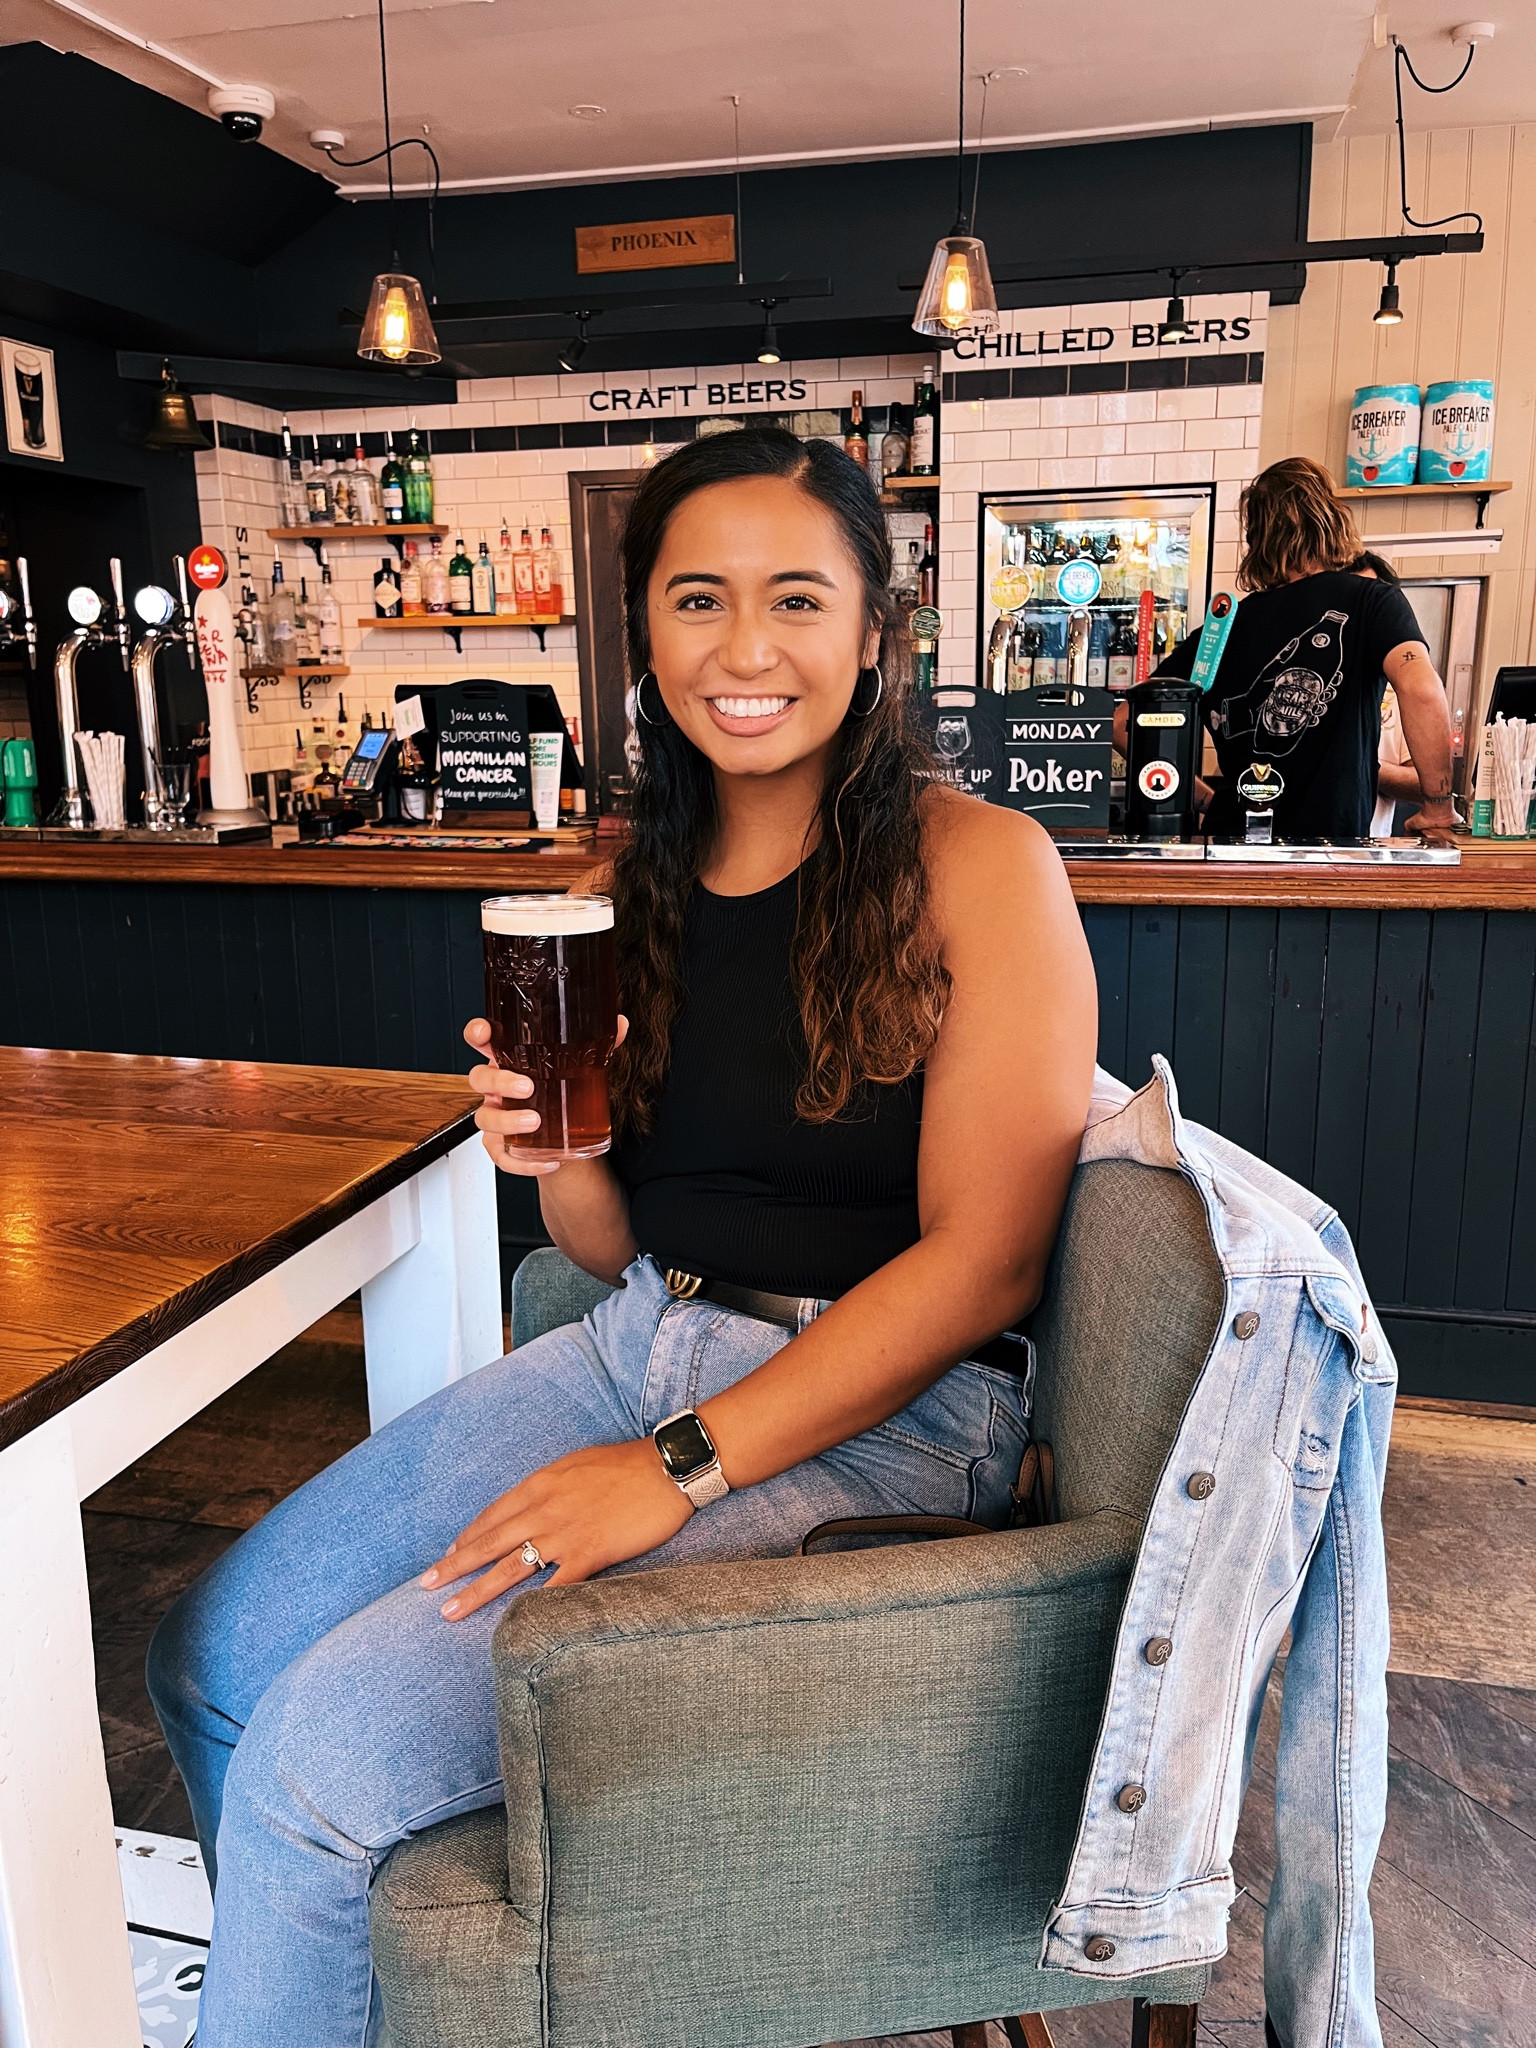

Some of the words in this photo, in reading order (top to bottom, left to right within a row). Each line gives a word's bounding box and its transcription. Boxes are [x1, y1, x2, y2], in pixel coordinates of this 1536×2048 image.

[612, 230, 697, 252] PHOENIX
[953, 327, 1114, 359] CHILLED
[1132, 317, 1250, 348] BEERS
[590, 386, 697, 411] CRAFT
[707, 379, 806, 405] BEERS
[1351, 413, 1362, 430] ICE
[1363, 410, 1406, 429] BREAKER
[1431, 408, 1448, 426] ICE
[1449, 406, 1490, 424] BREAKER
[1377, 427, 1390, 437] ALE
[450, 706, 475, 725] Join
[478, 711, 493, 722] us
[495, 704, 509, 722] in
[440, 730, 521, 744] SUPPORTING
[1012, 723, 1102, 740] MONDAY
[441, 750, 527, 768] MACMILLAN
[455, 766, 517, 784] CANCER
[970, 768, 993, 783] UP
[1007, 757, 1103, 793] Poker
